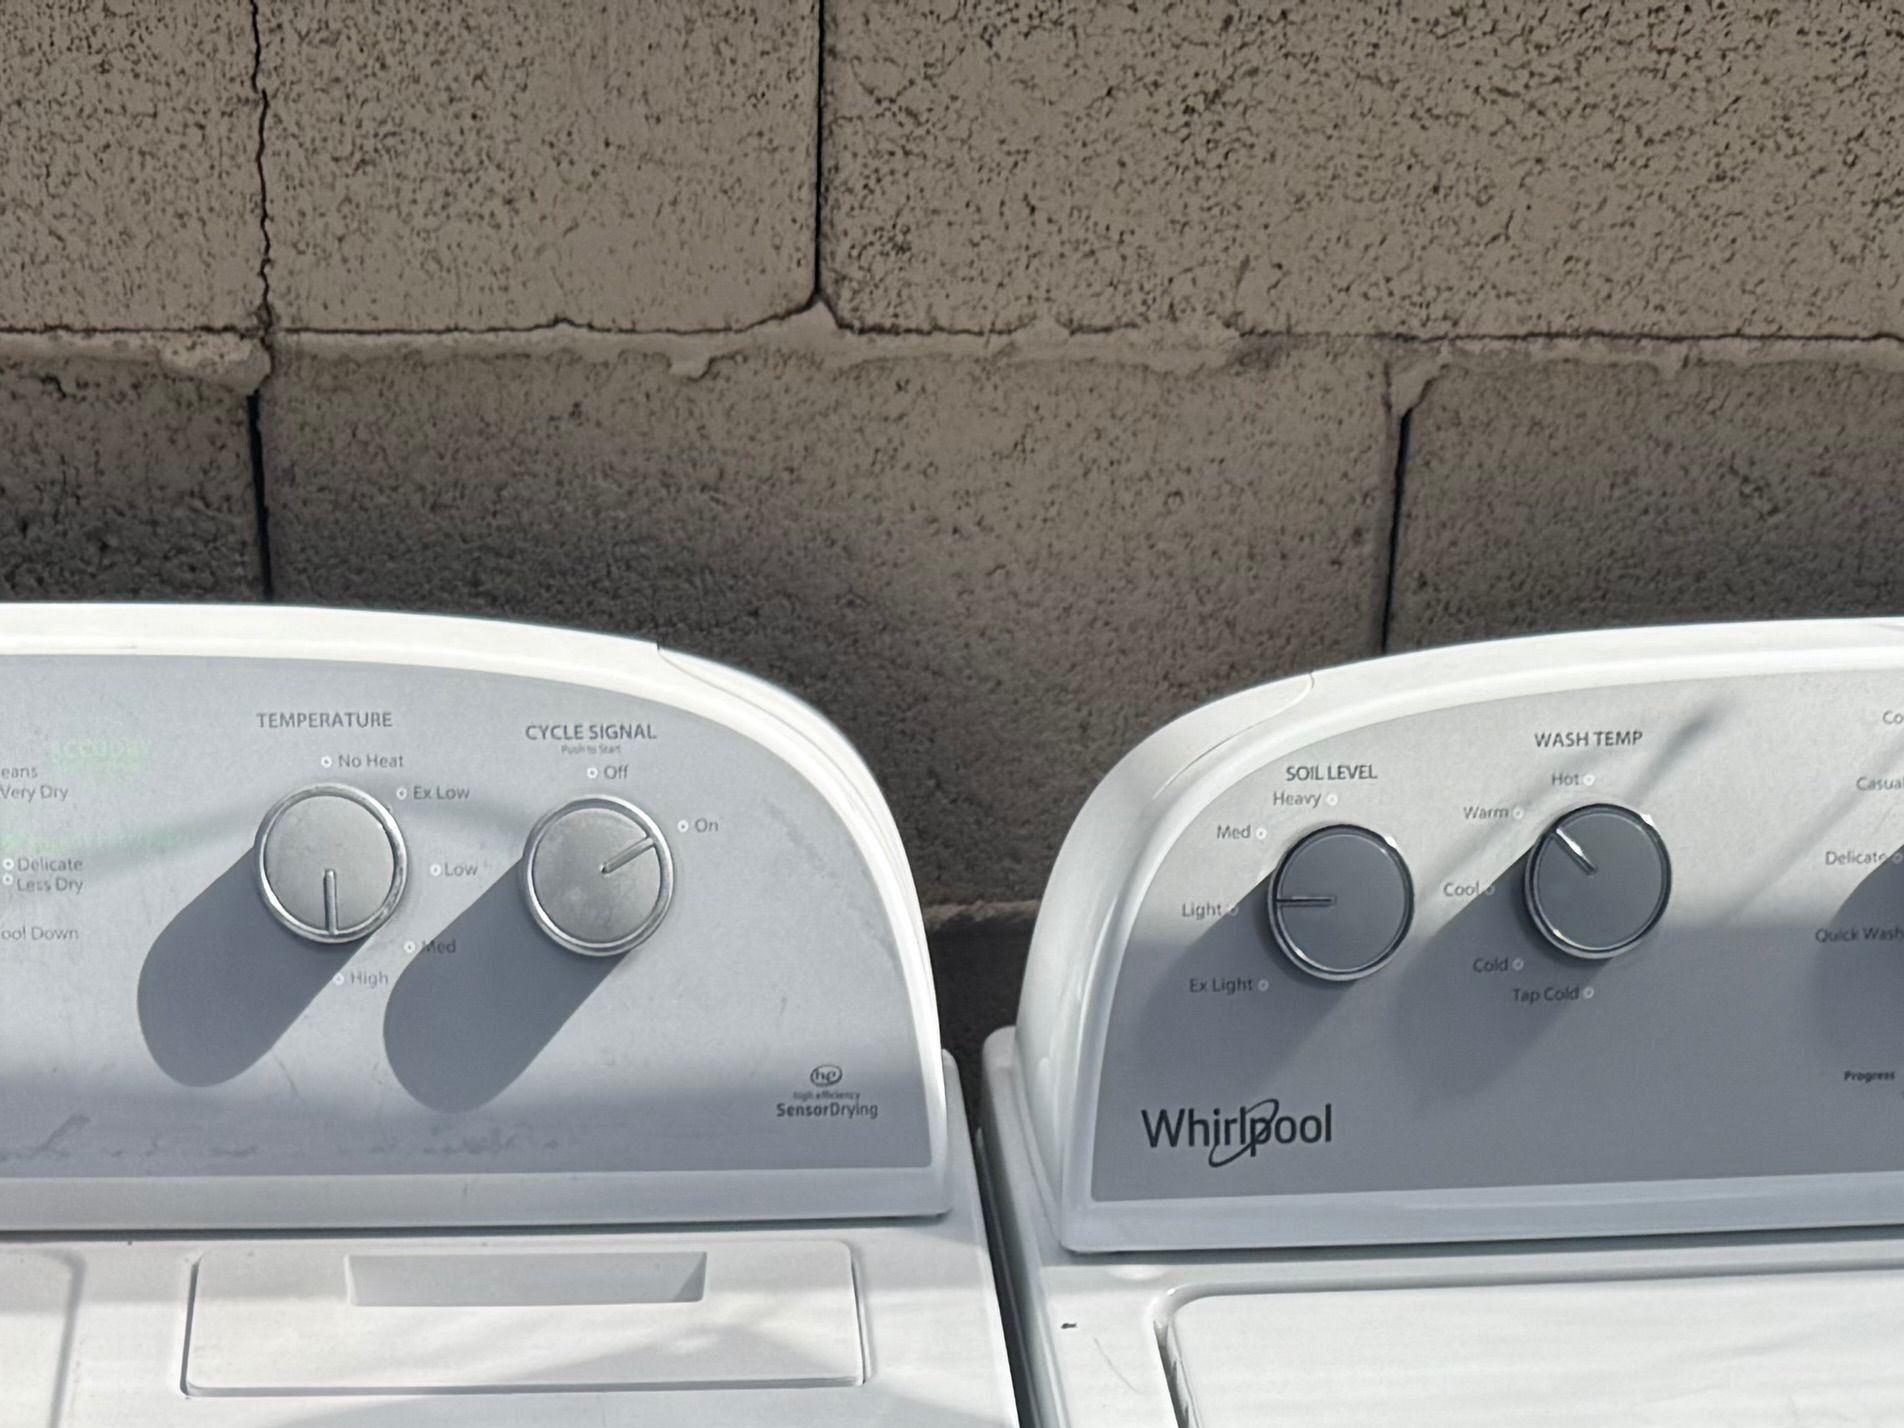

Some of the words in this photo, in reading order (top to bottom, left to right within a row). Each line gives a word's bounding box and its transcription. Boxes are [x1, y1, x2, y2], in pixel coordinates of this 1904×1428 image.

[256, 712, 393, 728] TEMPERATURE
[525, 725, 584, 741] CYCLE
[589, 724, 657, 740] SIGNAL
[1534, 732, 1589, 747] WASH
[1593, 731, 1643, 746] TEMP
[338, 755, 362, 768] No
[366, 755, 404, 768] Heat
[603, 765, 629, 780] Off
[1286, 766, 1324, 781] SOIL
[1328, 765, 1377, 780] LEVEL
[1551, 773, 1581, 786] Hot
[0, 786, 34, 803] Very
[40, 785, 69, 803] Dry
[413, 787, 432, 800] Ex
[437, 785, 470, 800] Low
[1273, 792, 1321, 809] Heavy
[1463, 806, 1509, 820] Warm
[694, 818, 719, 833] On
[1216, 825, 1251, 840] Med
[17, 857, 83, 872] Delicate
[1825, 851, 1885, 865] Delicate
[444, 863, 478, 877] Low
[17, 878, 51, 893] Less
[56, 878, 84, 894] Dry
[1443, 881, 1480, 897] Cool
[1182, 903, 1222, 920] Light
[31, 927, 79, 941] Down
[1815, 928, 1858, 944] Quick
[1862, 927, 1904, 941] Wash
[422, 940, 456, 953] Med
[1472, 957, 1509, 973] Cold
[350, 971, 389, 989] High
[1189, 978, 1207, 991] Ex
[1212, 977, 1253, 995] Light
[1512, 987, 1540, 1004] Tap
[1543, 986, 1579, 1001] Cold
[1844, 1071, 1895, 1083] Progress
[776, 1102, 878, 1119] SensorDrying
[1141, 1098, 1332, 1168] Whirlpool
